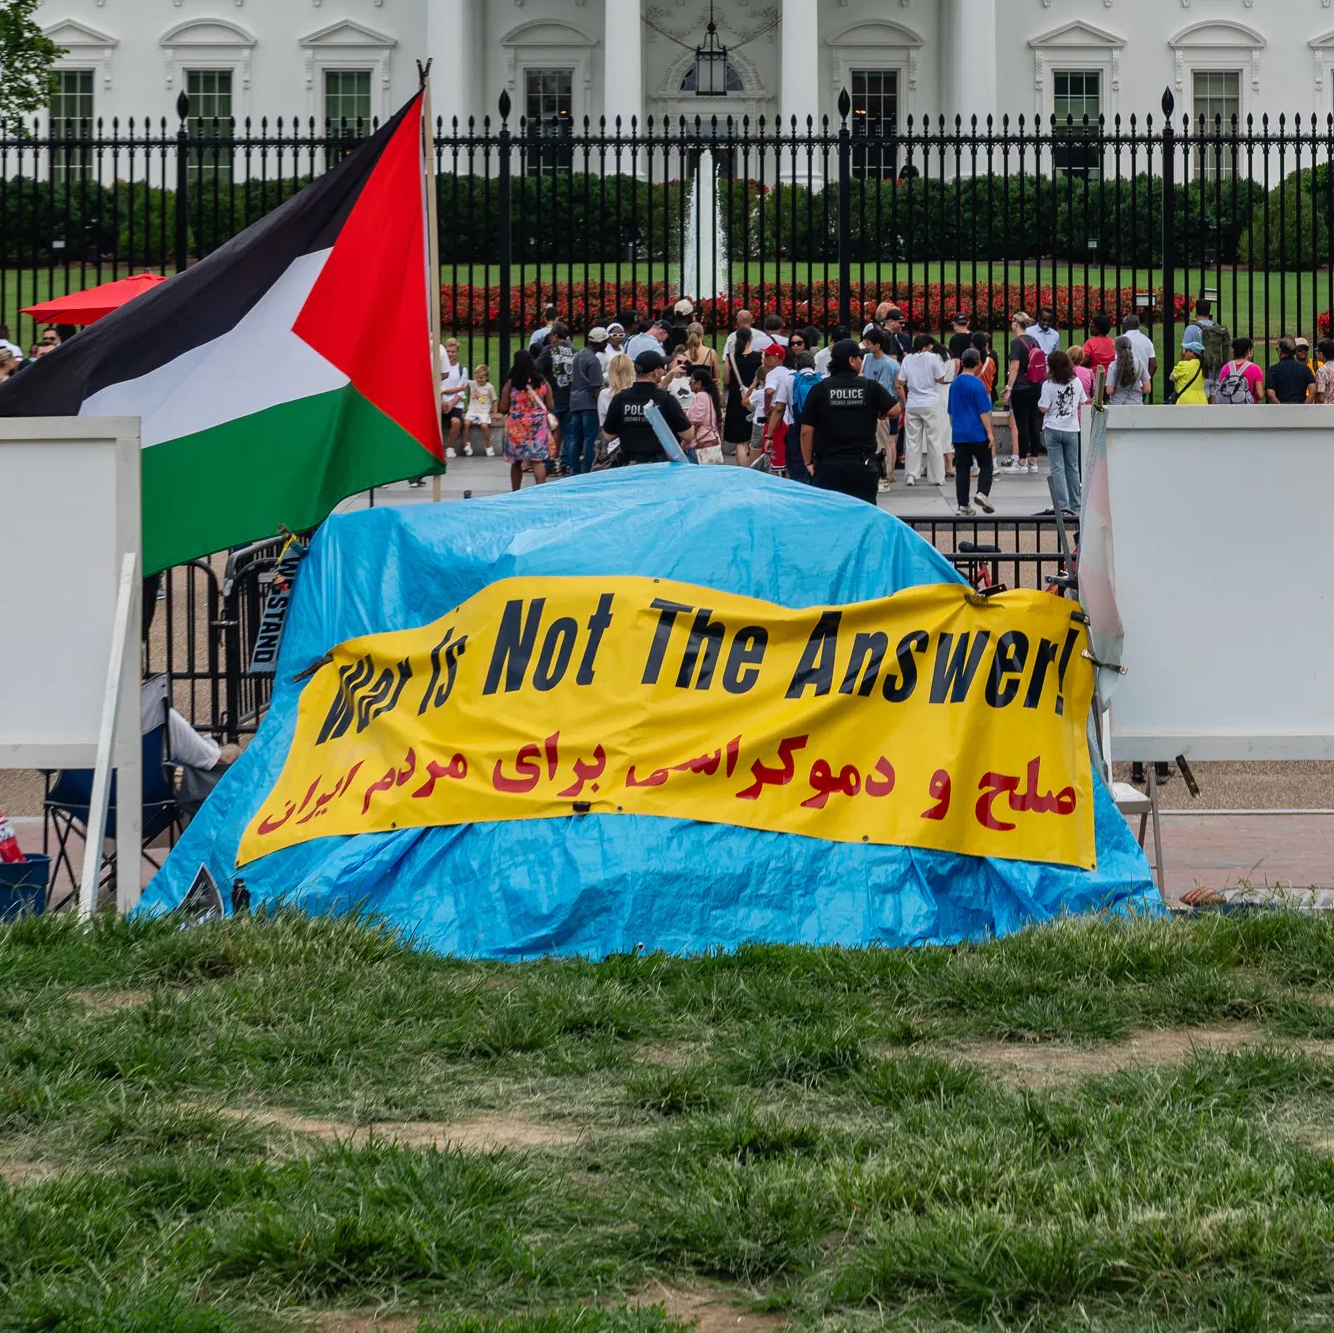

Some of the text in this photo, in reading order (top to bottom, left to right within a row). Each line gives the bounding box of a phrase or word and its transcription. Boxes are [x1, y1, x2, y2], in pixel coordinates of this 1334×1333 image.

[829, 389, 864, 399] POLICE
[253, 596, 289, 663] STAND
[316, 593, 1081, 746] War Is Not The Answer!
[257, 730, 1076, 835] صلح و دموکراسی برای مردم ایران
